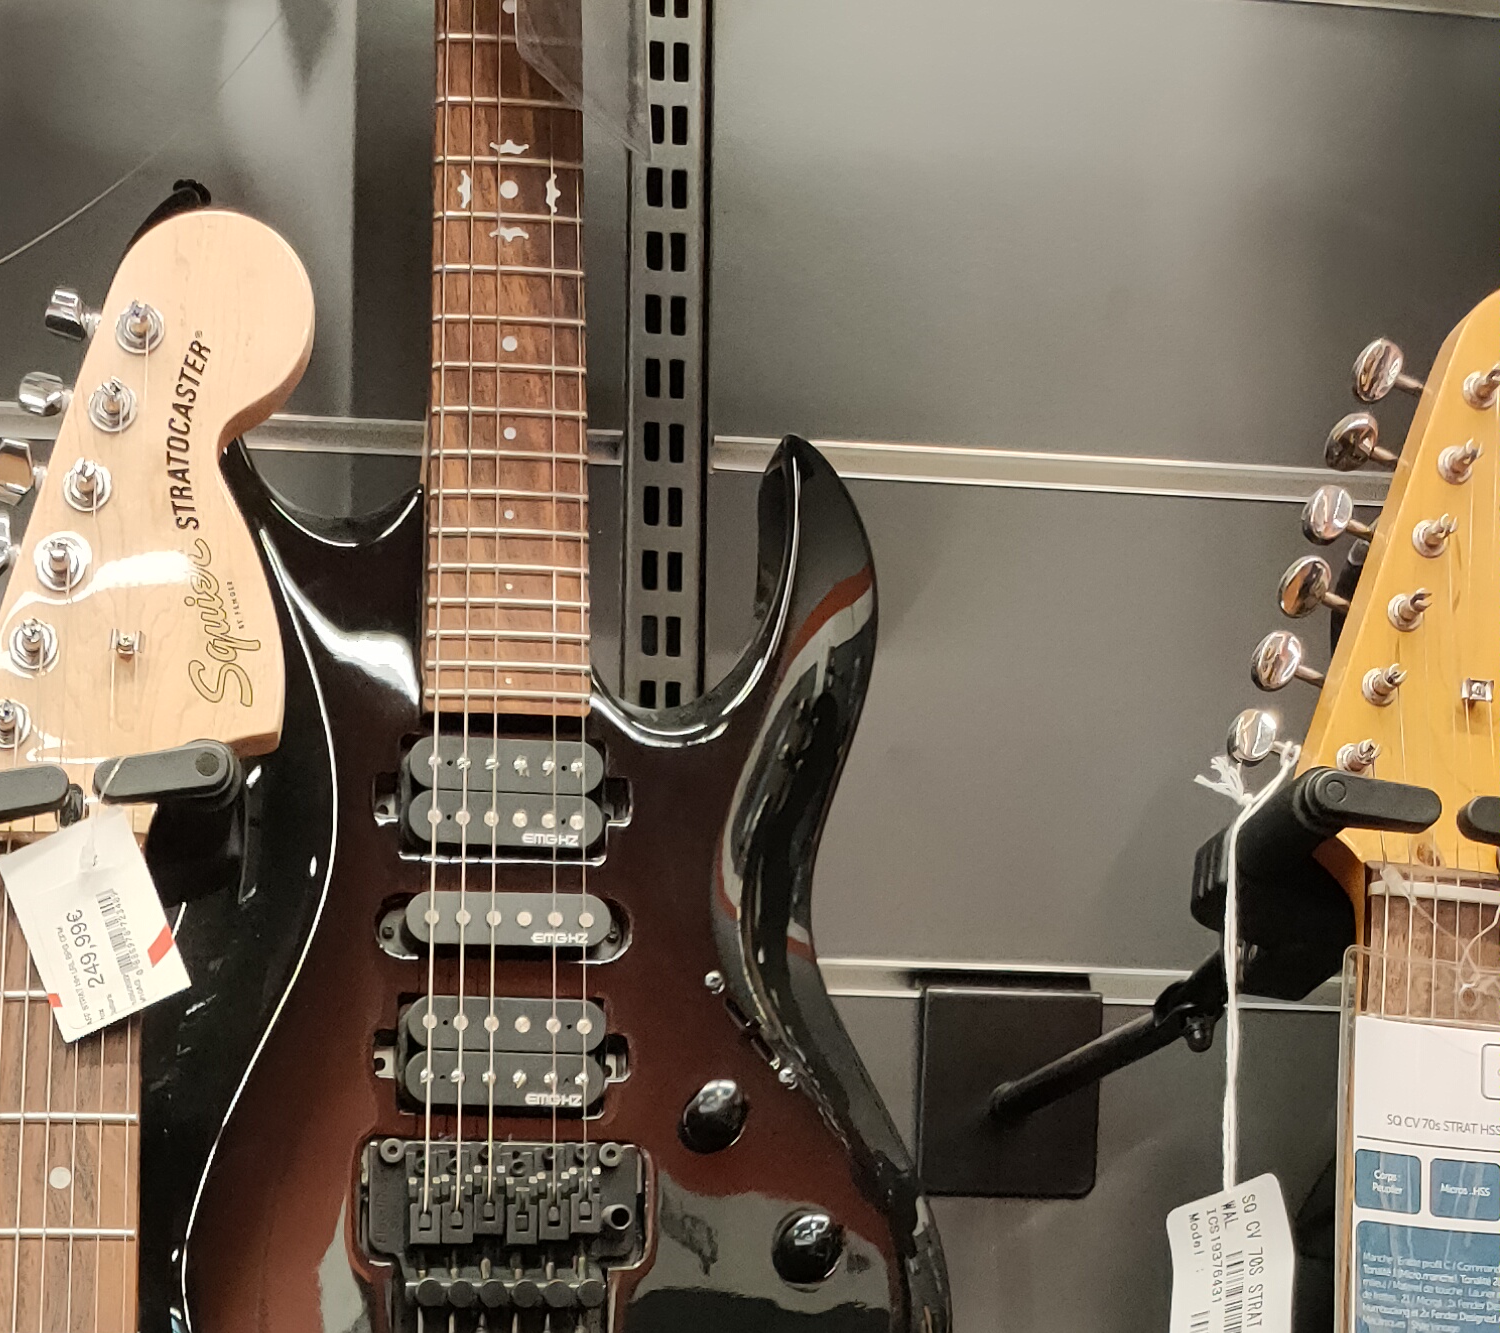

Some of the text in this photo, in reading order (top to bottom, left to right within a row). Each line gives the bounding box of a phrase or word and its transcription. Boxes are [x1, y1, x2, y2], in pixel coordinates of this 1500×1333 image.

[166, 337, 261, 707] Squier STRATOCASTER
[66, 909, 104, 988] 249,99€
[1387, 1114, 1401, 1127] SQ
[1404, 1116, 1421, 1129] CV
[1422, 1118, 1441, 1131] 70s
[1443, 1120, 1478, 1135] STRAT
[1221, 1199, 1239, 1229] WAL
[1242, 1194, 1258, 1214] SQ
[1246, 1220, 1262, 1239] CV
[1206, 1208, 1223, 1303] ICS19376431
[1248, 1246, 1265, 1276] 70S
[1246, 1283, 1264, 1328] STRAT
